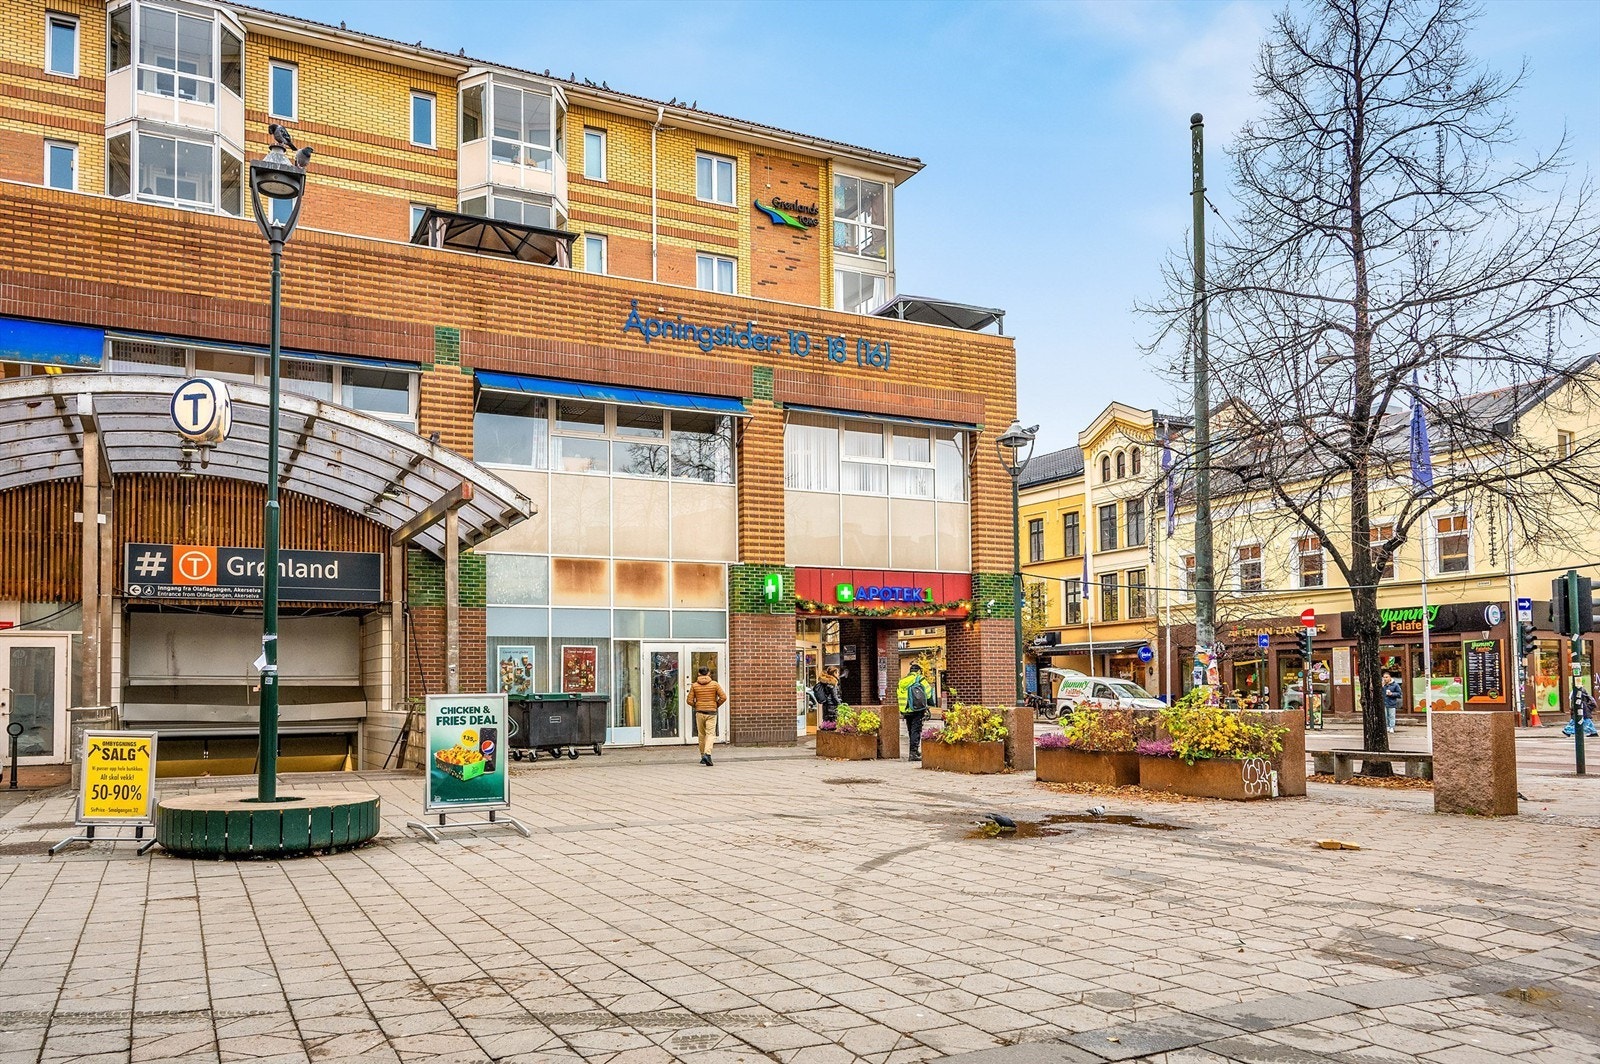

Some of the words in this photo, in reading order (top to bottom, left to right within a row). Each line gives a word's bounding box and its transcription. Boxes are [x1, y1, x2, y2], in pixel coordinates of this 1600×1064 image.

[771, 196, 819, 215] Grønlands
[623, 299, 781, 354] Åpningstider:
[856, 337, 891, 371] (16)
[183, 393, 207, 426] T
[187, 557, 204, 577] T
[226, 556, 339, 579] Grønland
[855, 585, 922, 602] APOTEK
[923, 587, 934, 603] 1
[1275, 623, 1328, 635] DARR
[1390, 620, 1424, 631] Falafe
[440, 706, 481, 715] CHICKEN
[482, 705, 491, 714] &
[436, 715, 467, 726] FRIES
[469, 715, 498, 725] DEAL
[101, 748, 136, 761] SALG
[91, 784, 142, 801] 50-90%
